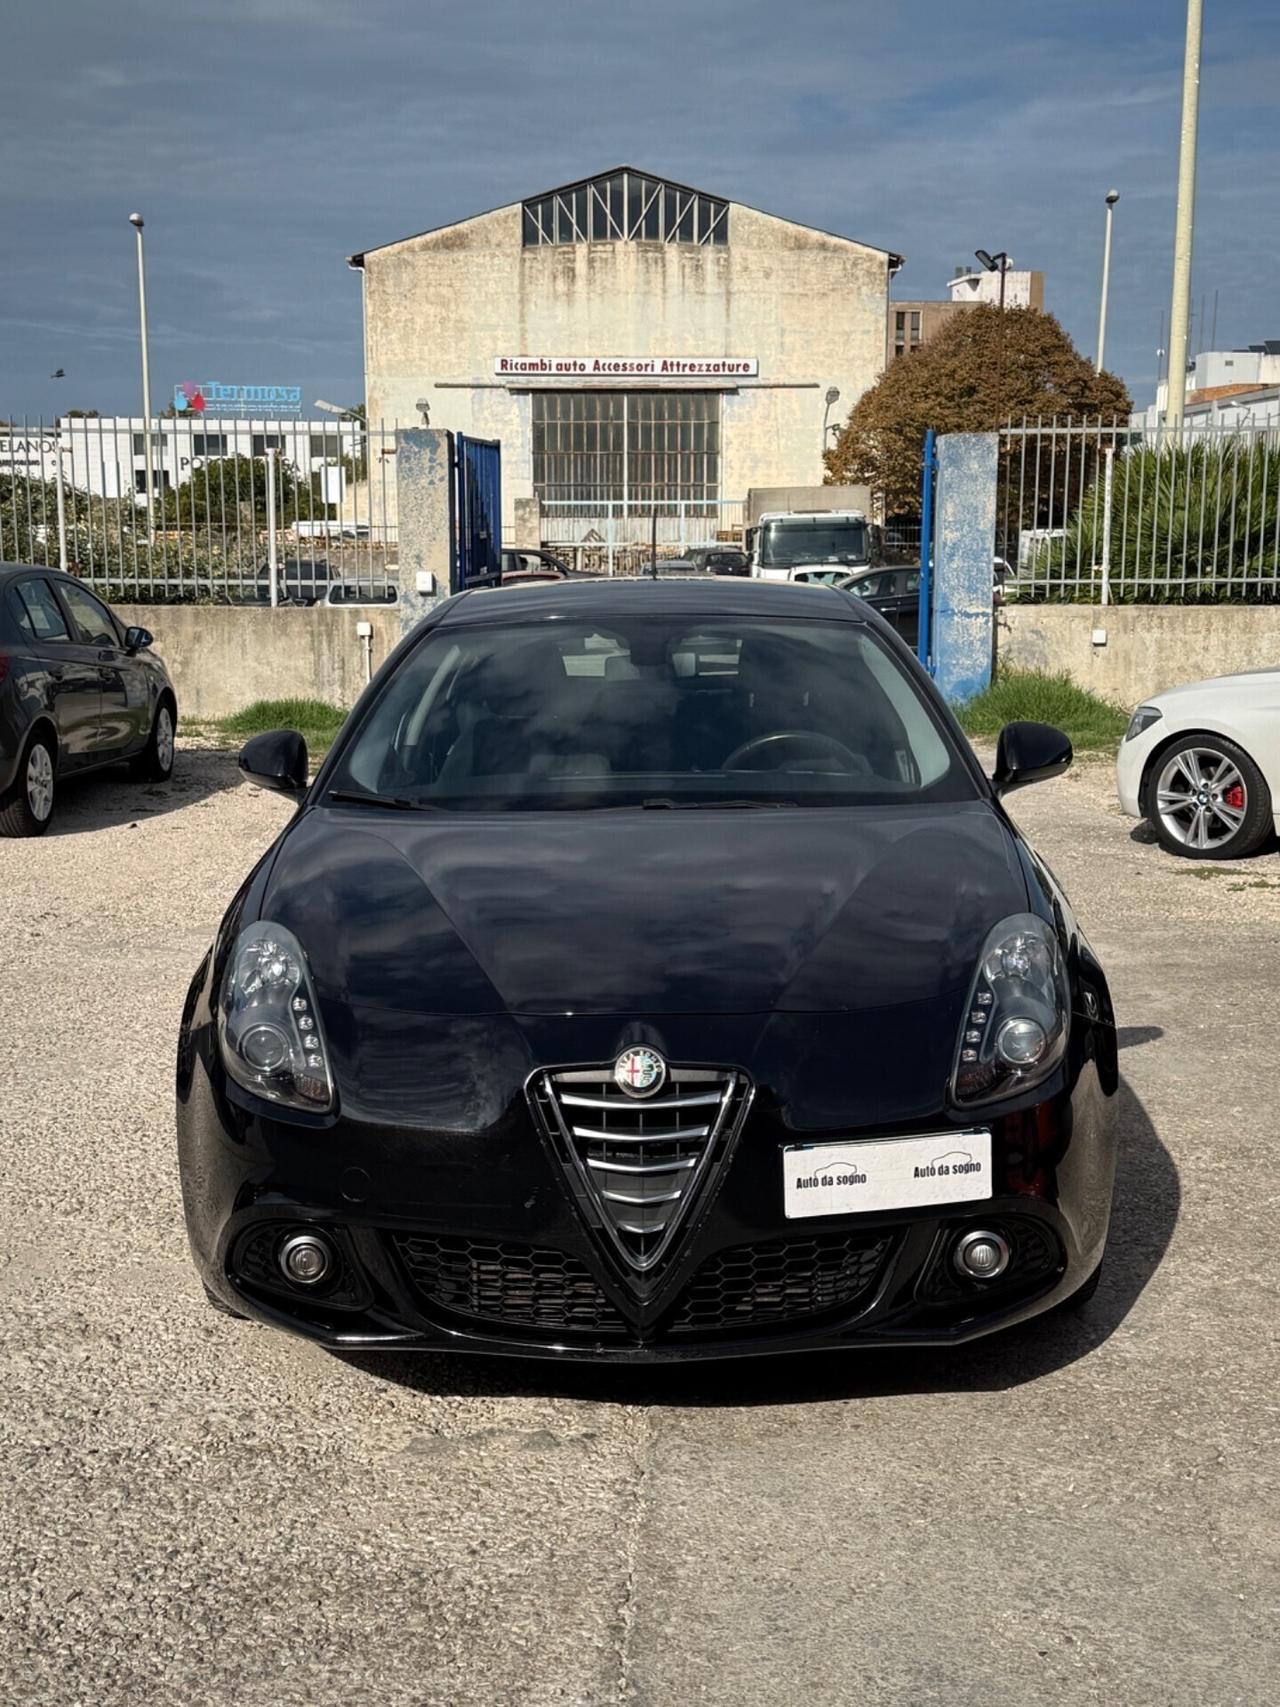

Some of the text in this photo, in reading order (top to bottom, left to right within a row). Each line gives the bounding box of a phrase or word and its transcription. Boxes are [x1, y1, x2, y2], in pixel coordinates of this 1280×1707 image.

[500, 359, 750, 372] Ricambi auto Accessori Attrezzature
[206, 381, 301, 401] Termosa
[914, 1162, 981, 1178] Auto da sogno
[796, 1173, 867, 1189] Auto da sogno
